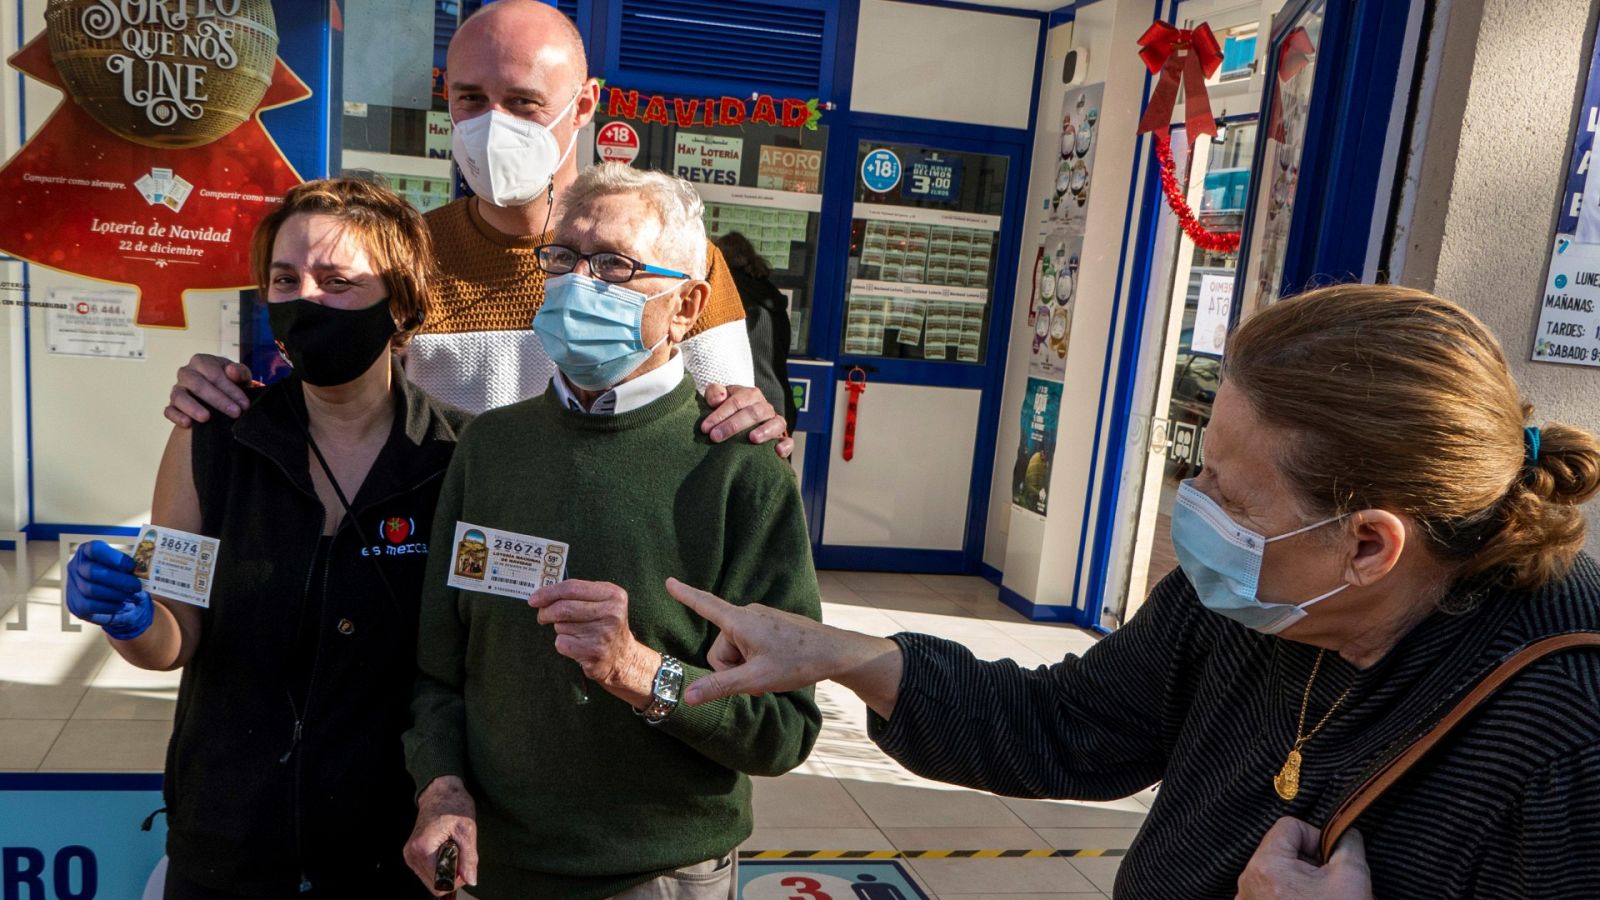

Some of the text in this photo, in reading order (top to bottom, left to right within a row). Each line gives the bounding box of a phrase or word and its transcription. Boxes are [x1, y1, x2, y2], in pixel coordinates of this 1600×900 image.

[122, 20, 239, 69] QUE NOS
[106, 53, 209, 126] UNE
[608, 87, 813, 128] NAVIDAD
[429, 123, 449, 135] HAY
[605, 126, 630, 142] +18
[677, 143, 740, 160] HAY LOTERÍA
[760, 149, 821, 170] AFORO
[701, 158, 713, 167] DE
[866, 159, 892, 178] +18
[23, 173, 127, 191] Compartir como siempre.
[678, 165, 737, 186] REYES
[199, 189, 241, 200] Compartir
[242, 194, 264, 202] como
[148, 221, 166, 237] de
[170, 225, 232, 243] Navidad
[119, 239, 204, 257] 22 de diciembre
[1575, 271, 1600, 288] LUNE
[1545, 293, 1595, 313] MAÑANAS:
[1546, 321, 1586, 338] TARDES:
[160, 536, 199, 554] 28674
[361, 545, 381, 556] es
[493, 539, 543, 557] 28674
[780, 876, 834, 900] 3
